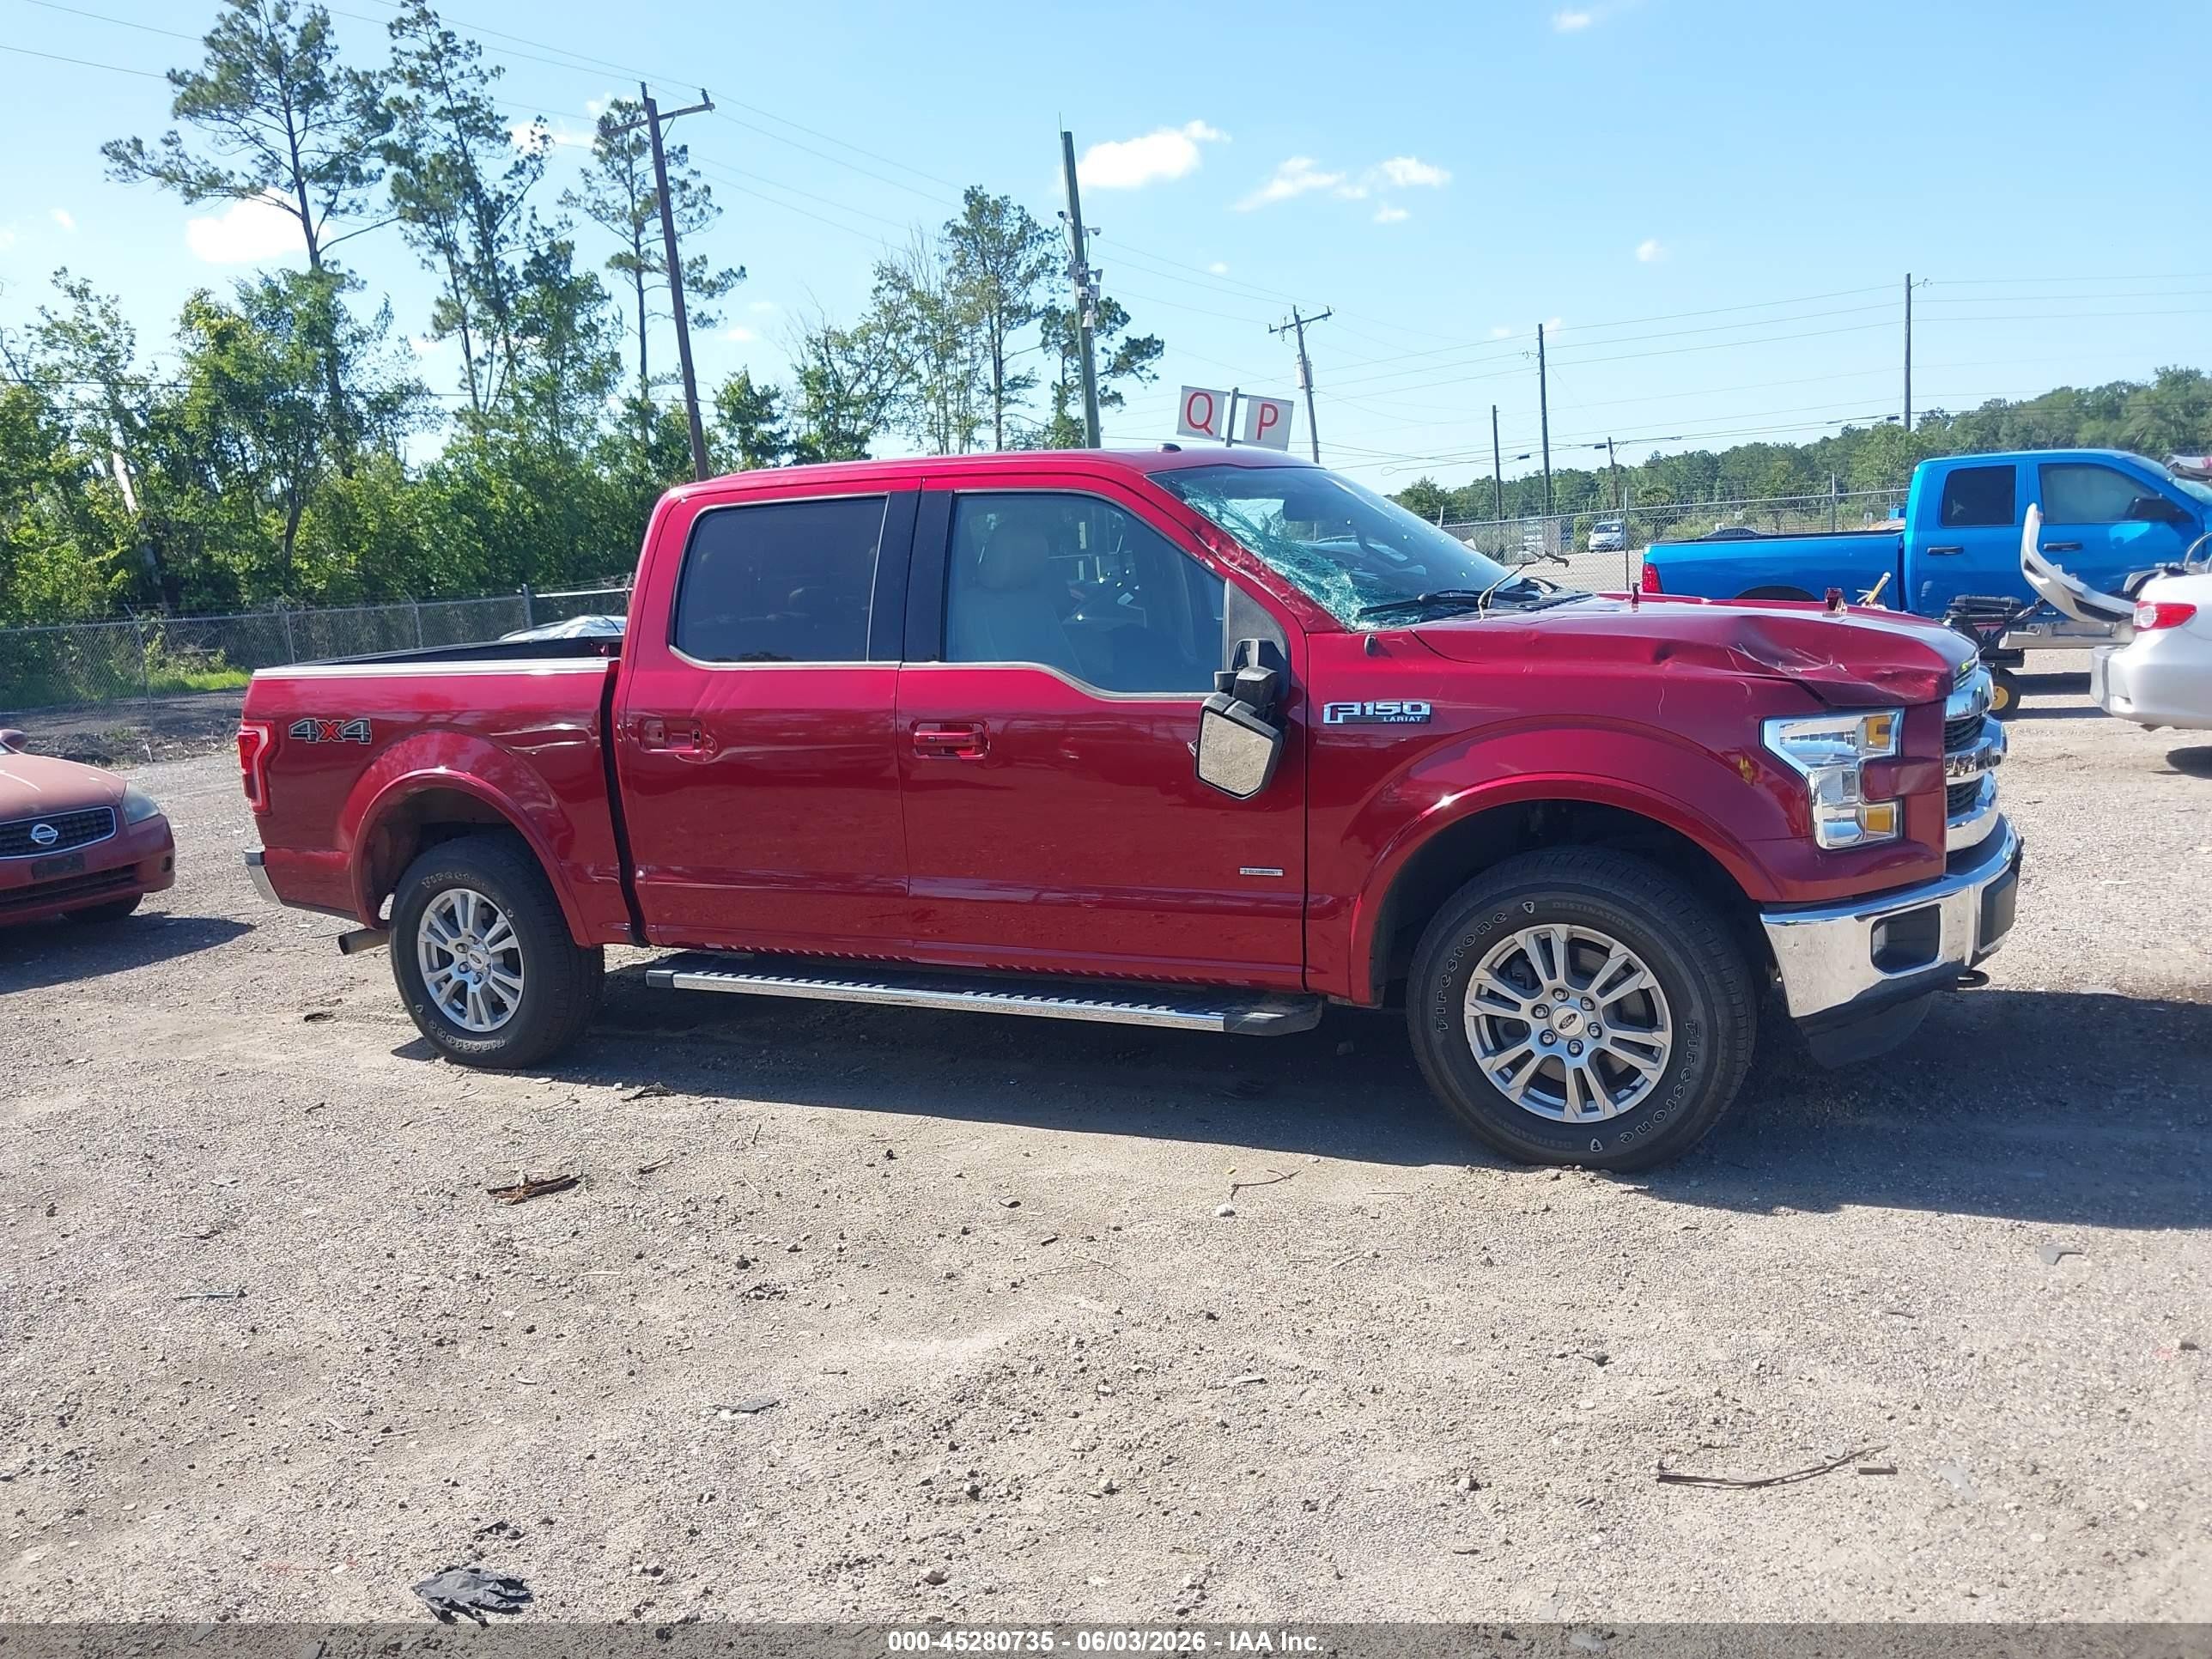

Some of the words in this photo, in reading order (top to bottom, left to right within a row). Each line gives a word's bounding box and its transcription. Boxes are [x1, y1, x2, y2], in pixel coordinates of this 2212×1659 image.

[1187, 392, 1214, 436] Q
[1256, 403, 1279, 441] P
[1433, 912, 1508, 1033] Firestone
[1620, 1019, 1700, 1145] Firestone
